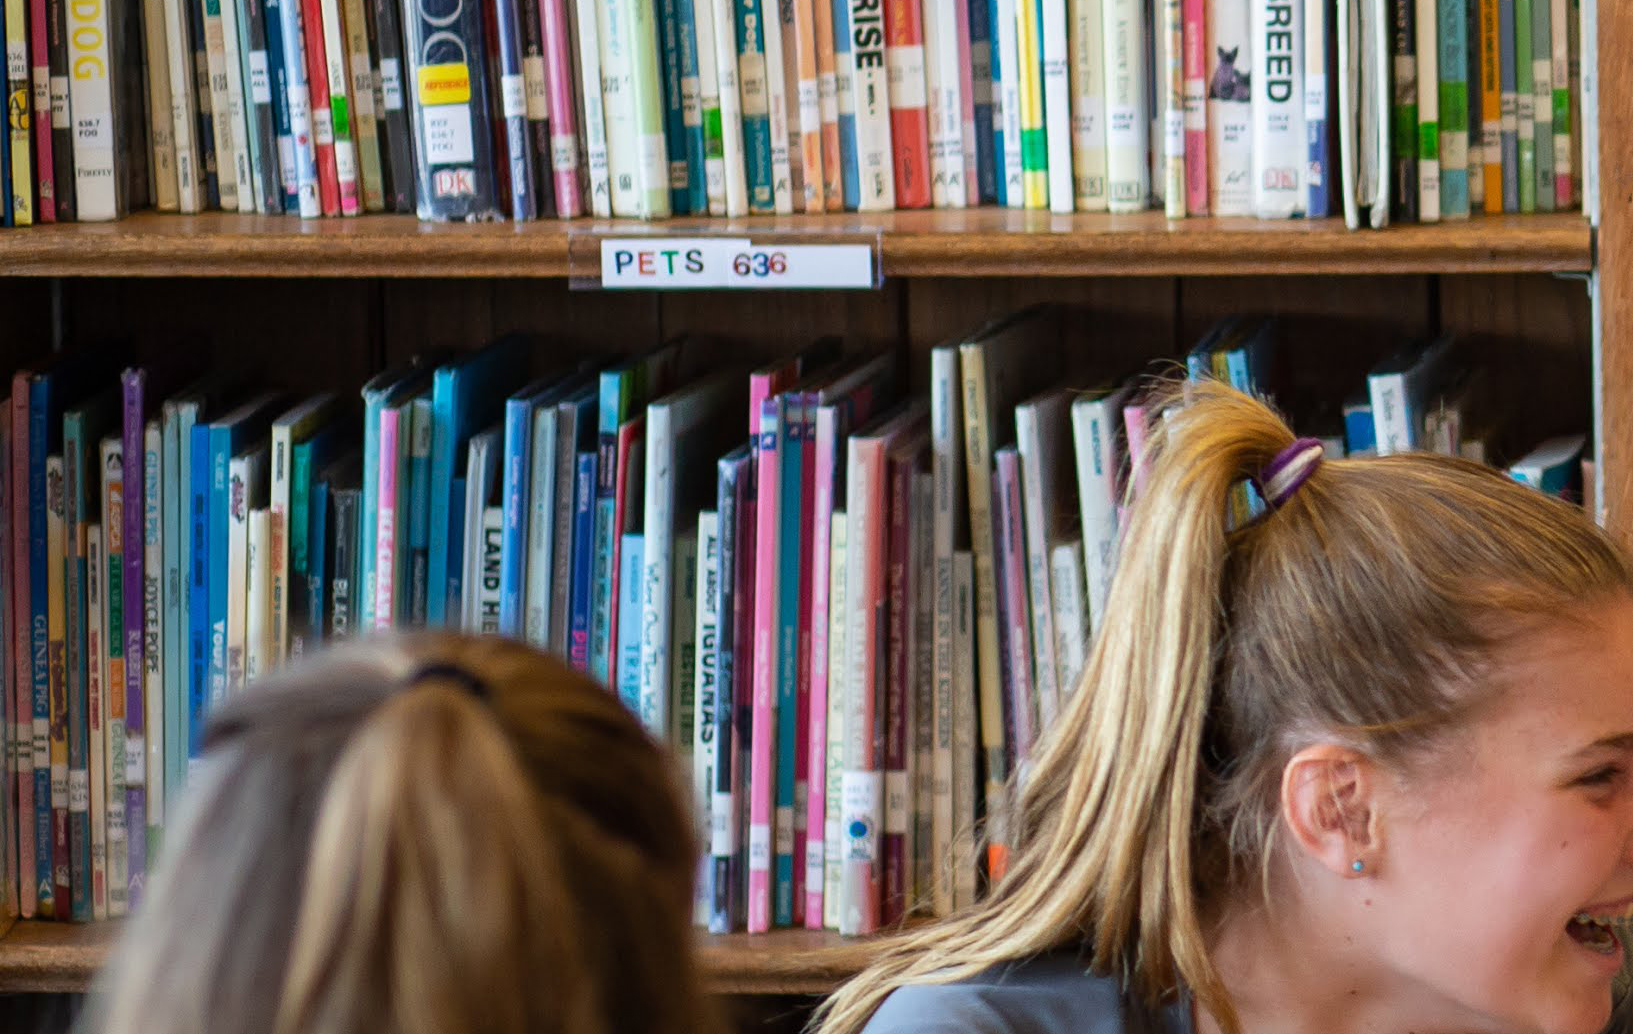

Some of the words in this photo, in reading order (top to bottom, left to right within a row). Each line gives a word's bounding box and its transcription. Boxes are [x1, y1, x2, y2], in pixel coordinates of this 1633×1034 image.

[1265, 0, 1293, 103] REED
[437, 173, 474, 197] DK
[1265, 169, 1297, 190] DK
[615, 250, 705, 276] PETS
[733, 252, 787, 277] 636
[145, 450, 159, 513] GUINEA
[146, 516, 160, 547] PIG
[481, 527, 503, 591] LAND
[144, 575, 160, 628] JOYCE
[332, 578, 350, 636] BLACK
[704, 569, 717, 616] ABOUT
[34, 614, 49, 690] GUINEA
[127, 630, 143, 688] RABBIT
[144, 631, 160, 674] POPE
[211, 618, 226, 668] Your
[35, 692, 49, 714] PIG
[699, 621, 717, 745] IGUANAS
[937, 676, 951, 749] KITCHEN
